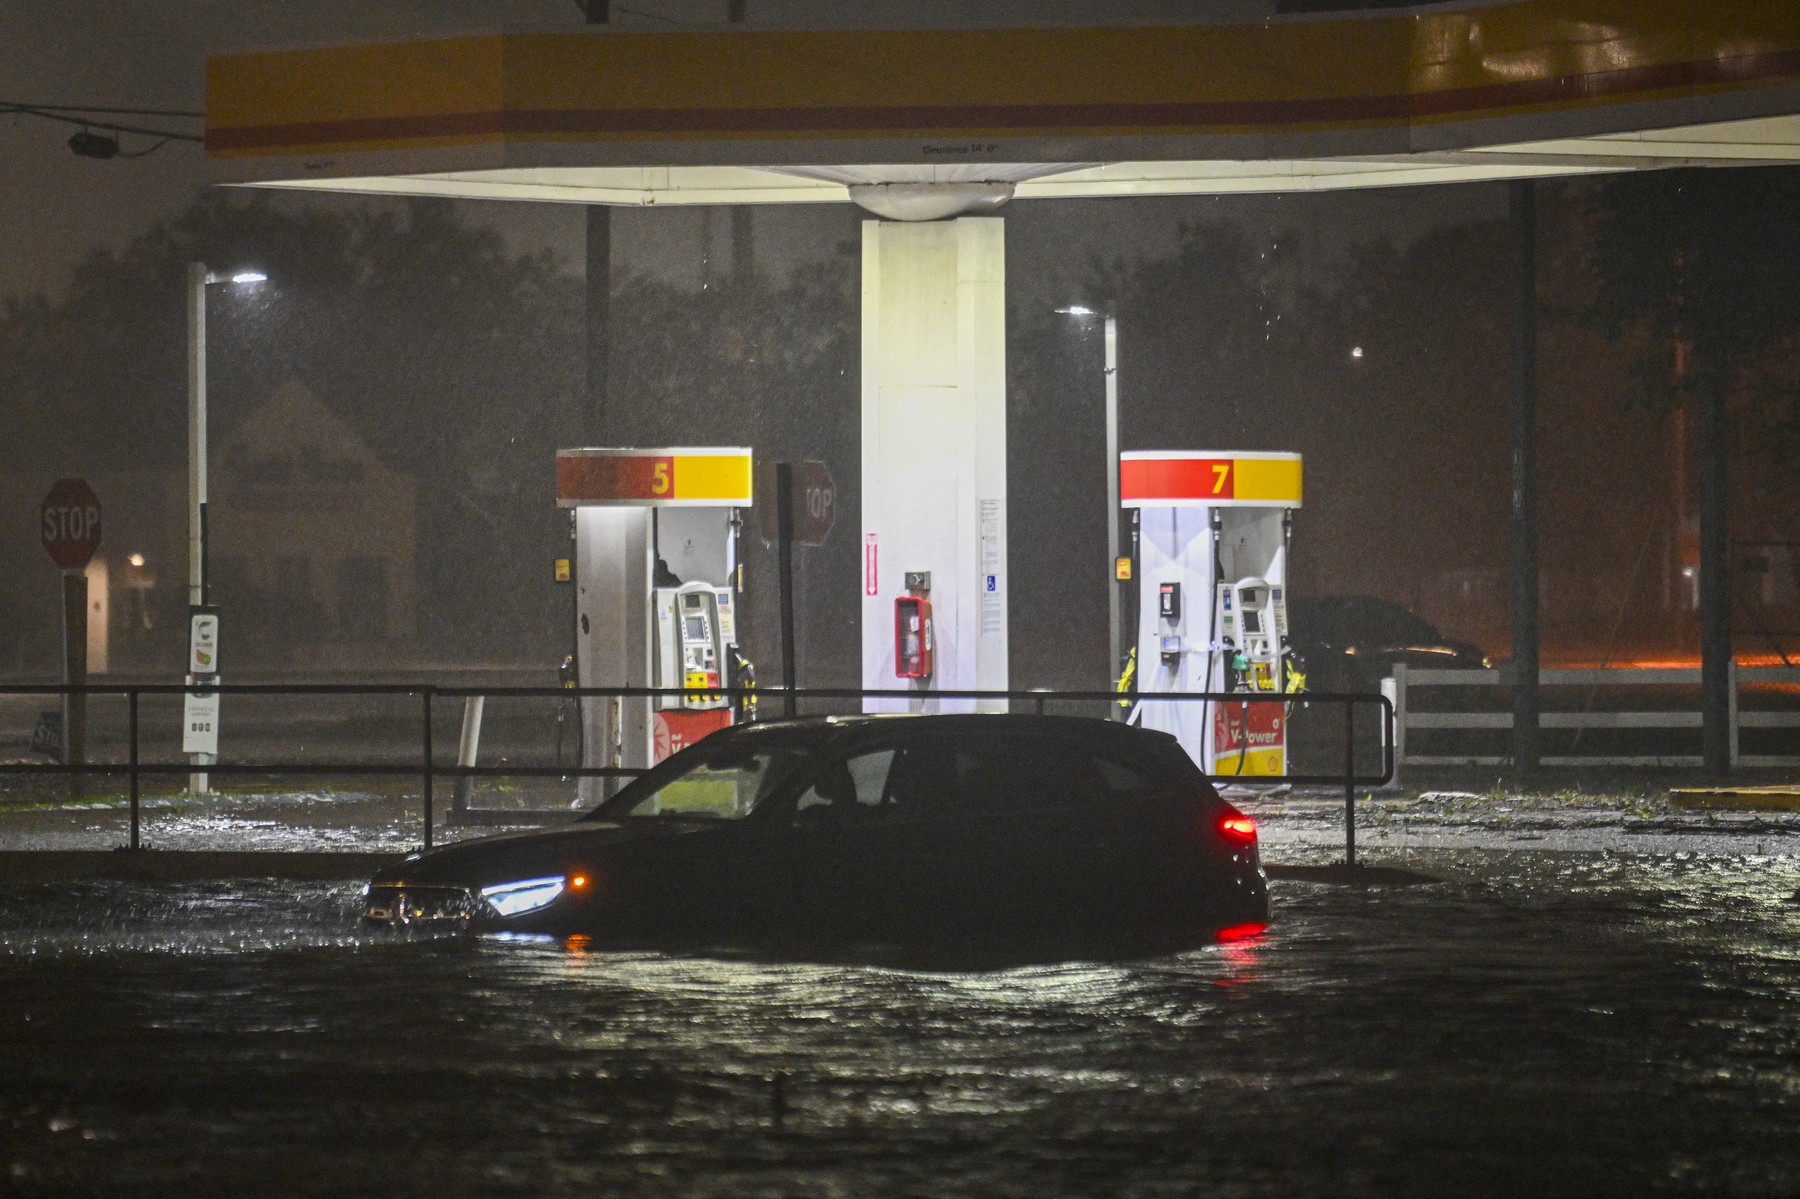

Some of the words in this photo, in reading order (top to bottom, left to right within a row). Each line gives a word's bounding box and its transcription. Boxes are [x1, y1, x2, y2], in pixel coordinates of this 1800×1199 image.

[652, 463, 670, 495] 5
[1211, 465, 1230, 494] 7
[806, 487, 832, 519] TOP
[44, 505, 99, 542] STOP
